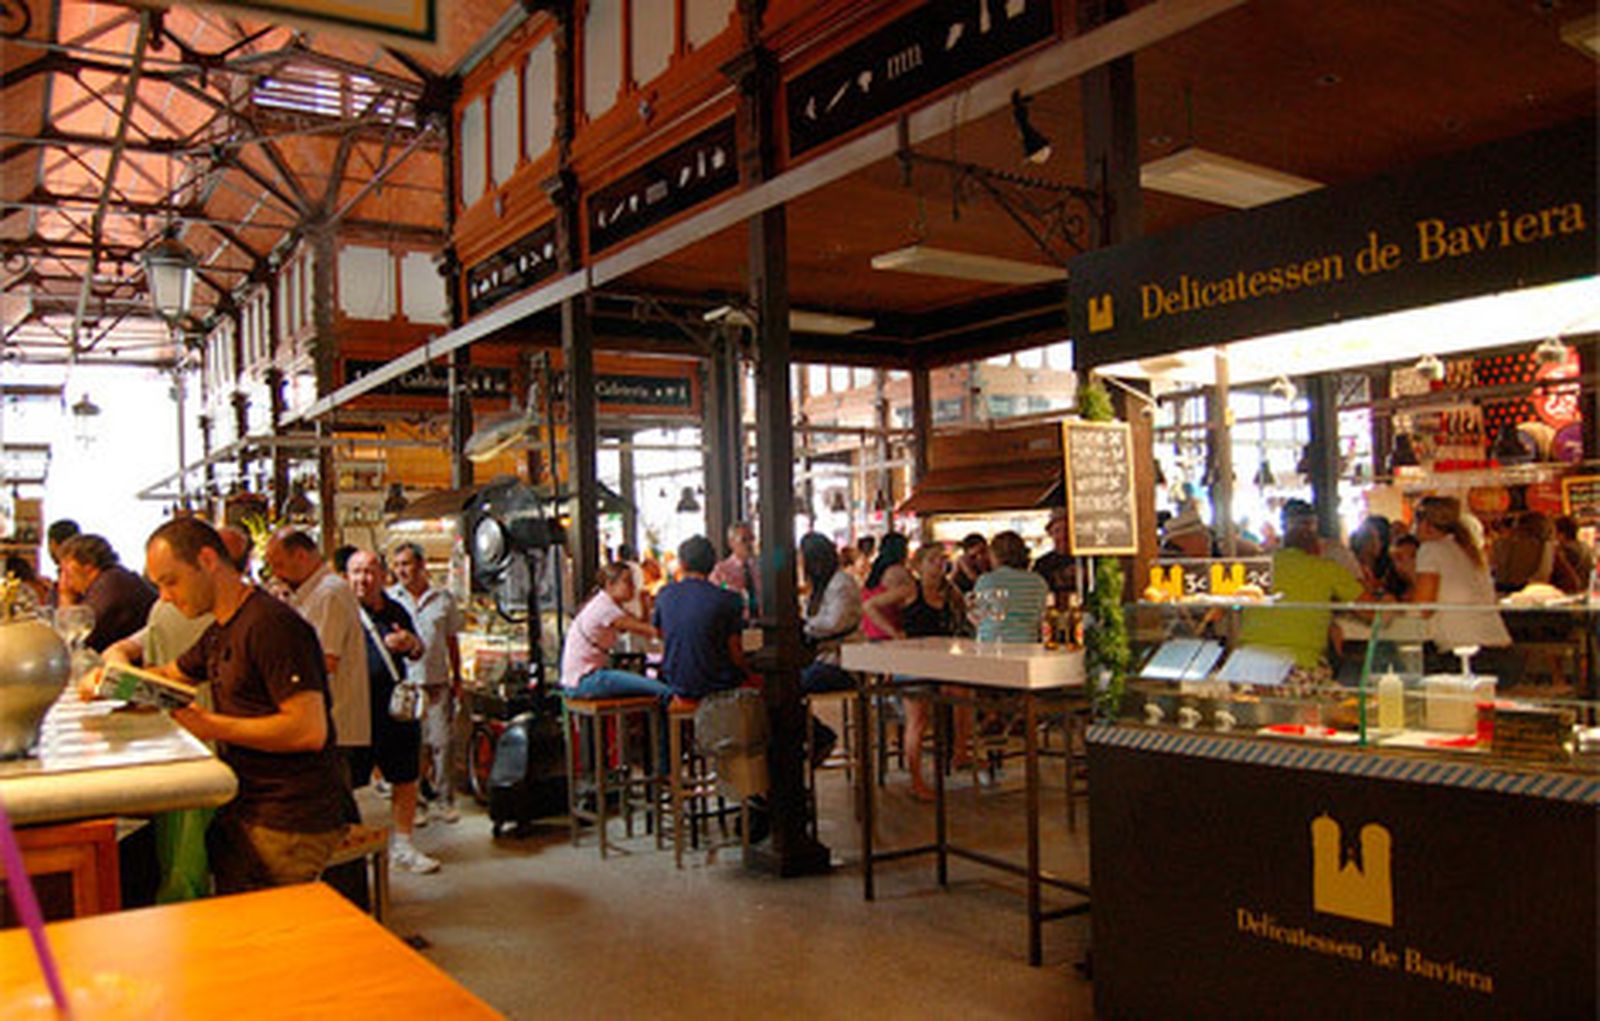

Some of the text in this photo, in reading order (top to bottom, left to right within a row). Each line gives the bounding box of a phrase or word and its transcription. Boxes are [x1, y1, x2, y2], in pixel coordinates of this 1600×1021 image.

[1140, 202, 1586, 320] Delicatessen de Baviera
[1236, 907, 1493, 993] Delicatessen de Baviera
